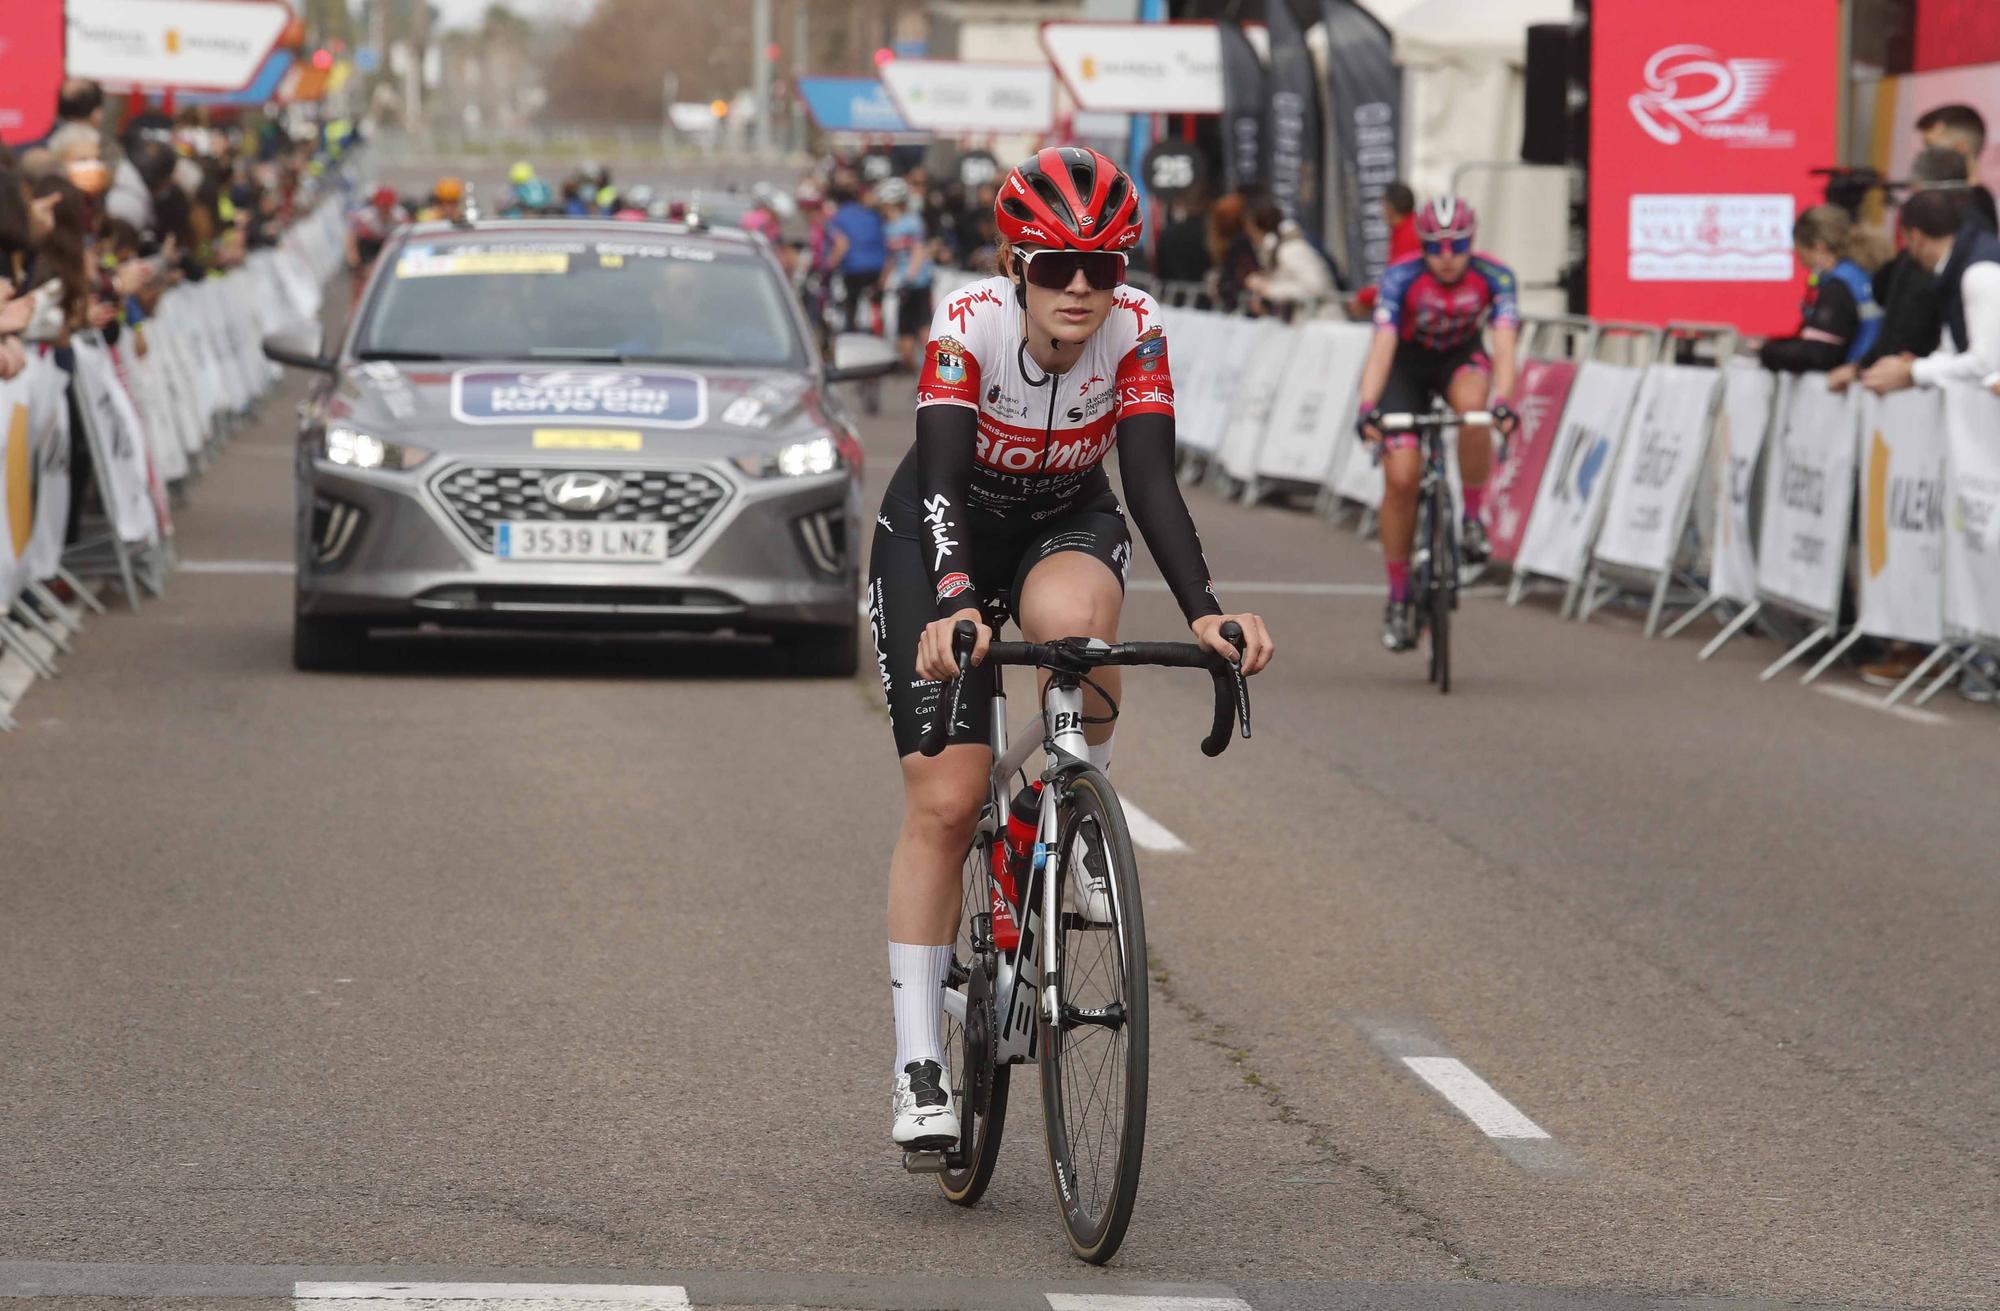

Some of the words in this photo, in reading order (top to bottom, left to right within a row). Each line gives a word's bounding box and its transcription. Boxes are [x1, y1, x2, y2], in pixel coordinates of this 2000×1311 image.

[520, 525, 594, 553] 3539
[600, 525, 657, 556] LNZ
[876, 577, 887, 640] MultiServicios
[1054, 710, 1083, 732] BH
[1055, 1159, 1072, 1202] SPRINT
